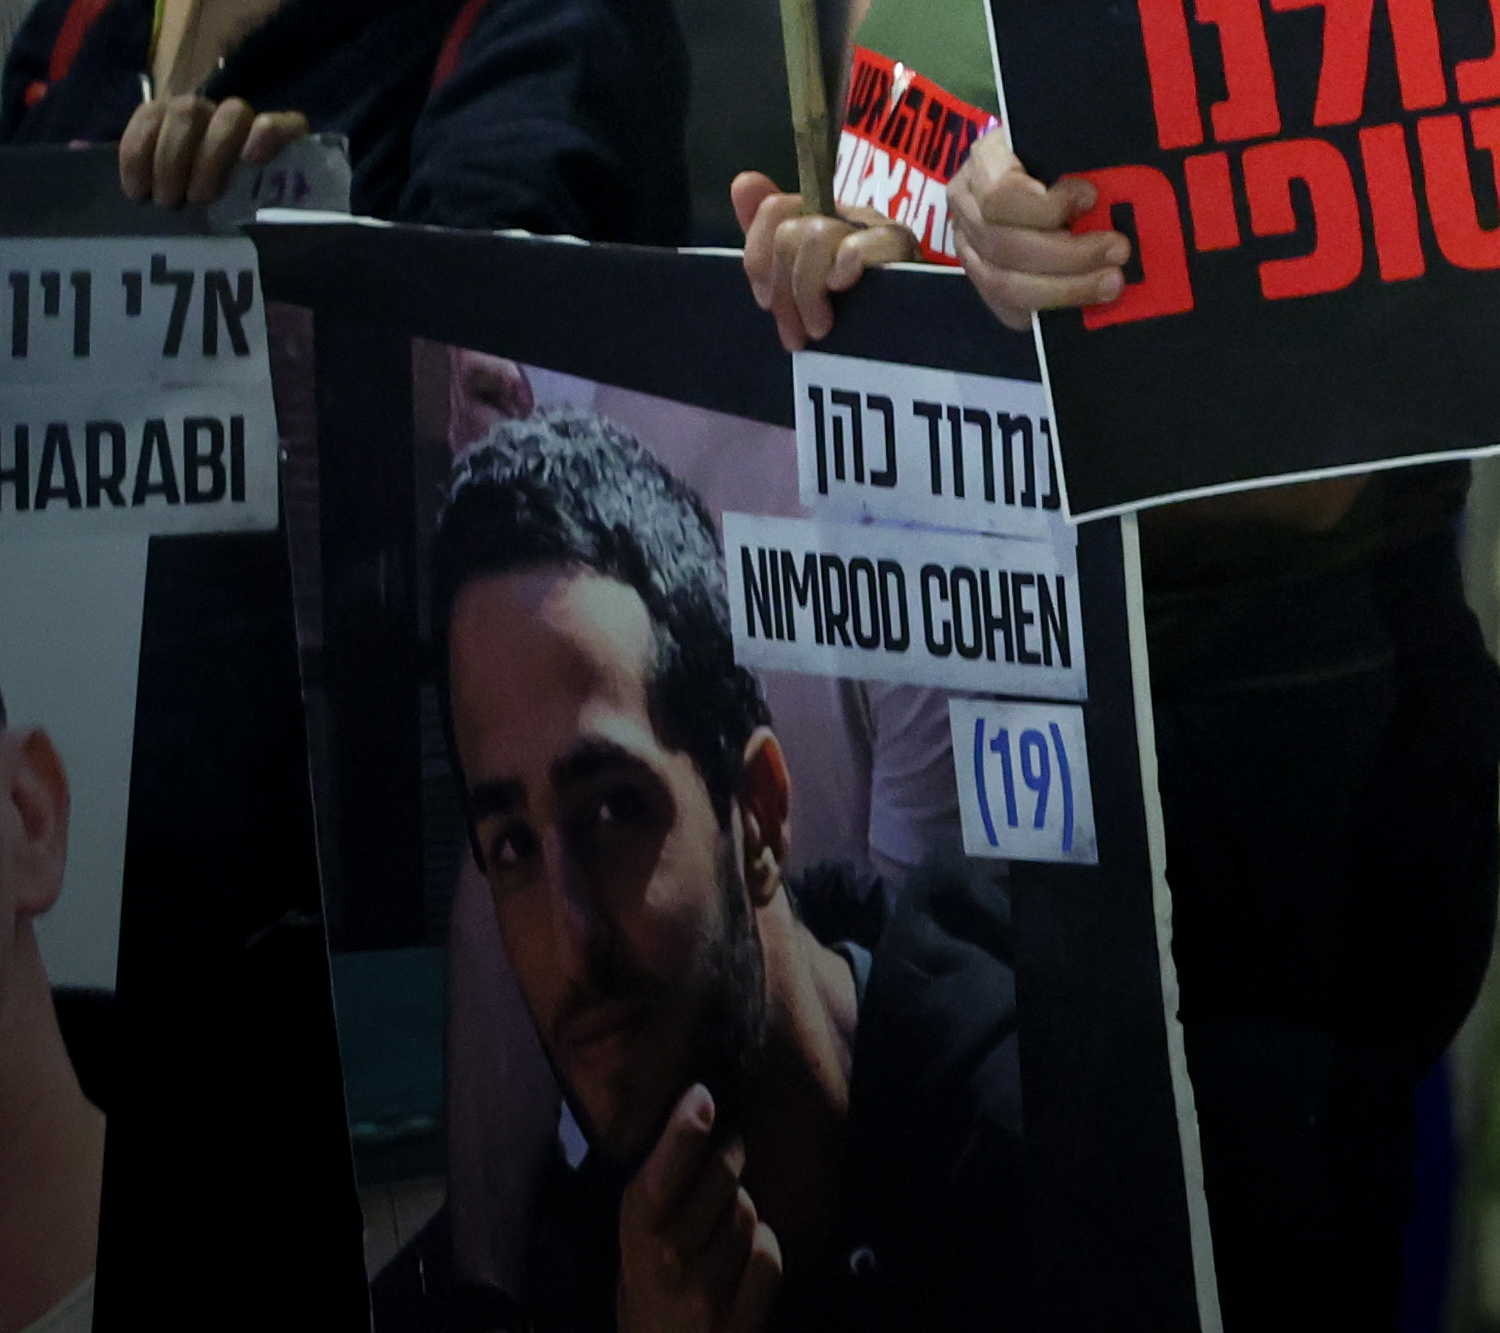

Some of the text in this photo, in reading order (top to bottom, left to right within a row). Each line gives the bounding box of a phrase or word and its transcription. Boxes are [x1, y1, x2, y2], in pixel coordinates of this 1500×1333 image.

[9, 253, 254, 358] אלי ויו
[0, 415, 247, 511] HARABI
[807, 385, 1061, 511] נמרוד כהן
[740, 545, 1073, 669] NIMROD COHEN
[973, 717, 1074, 852] (19)
